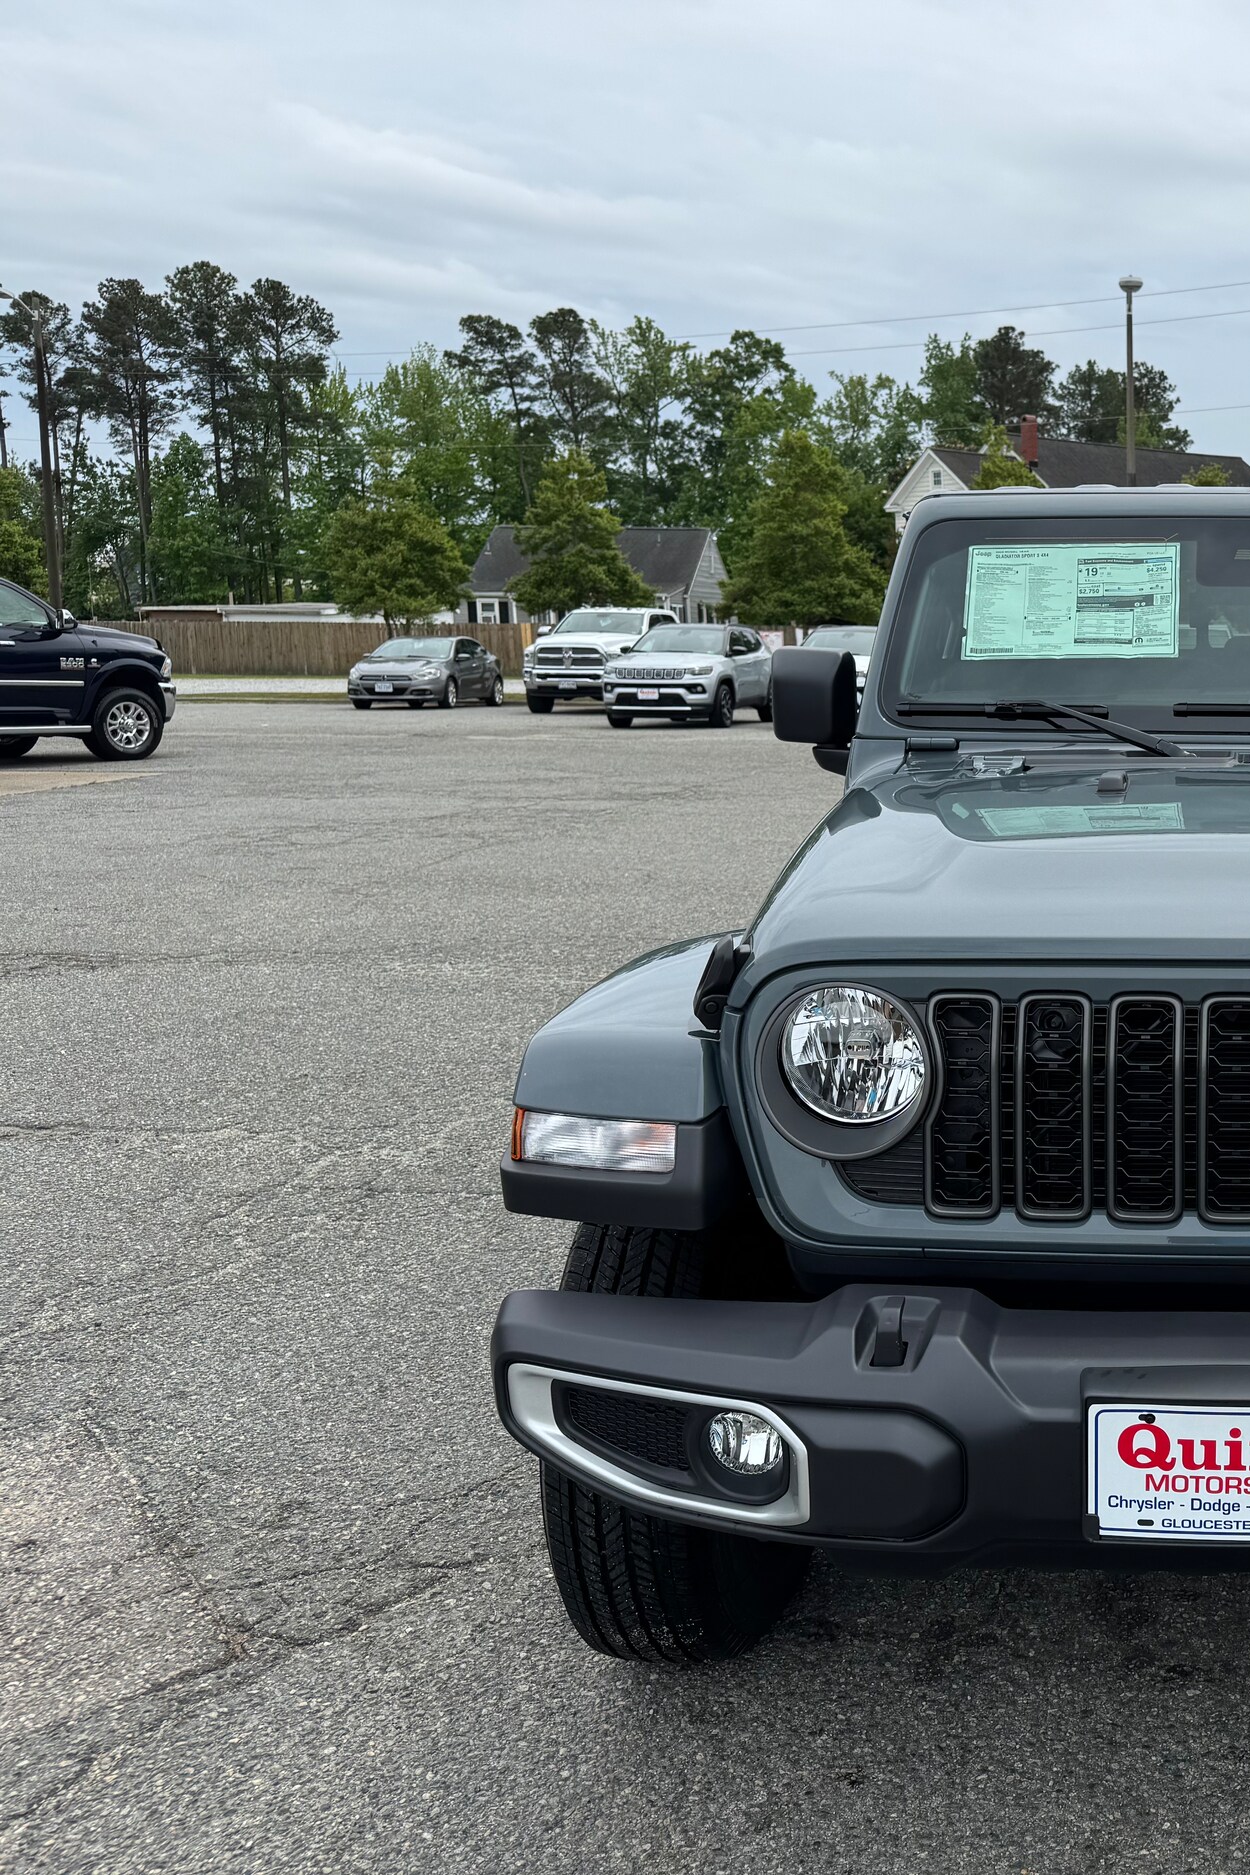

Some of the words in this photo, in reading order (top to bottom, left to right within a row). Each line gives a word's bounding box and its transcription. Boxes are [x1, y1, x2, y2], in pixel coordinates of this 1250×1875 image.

[1085, 567, 1098, 577] 19
[1108, 1495, 1174, 1512] Chrysler
[1191, 1498, 1241, 1516] Dodge
